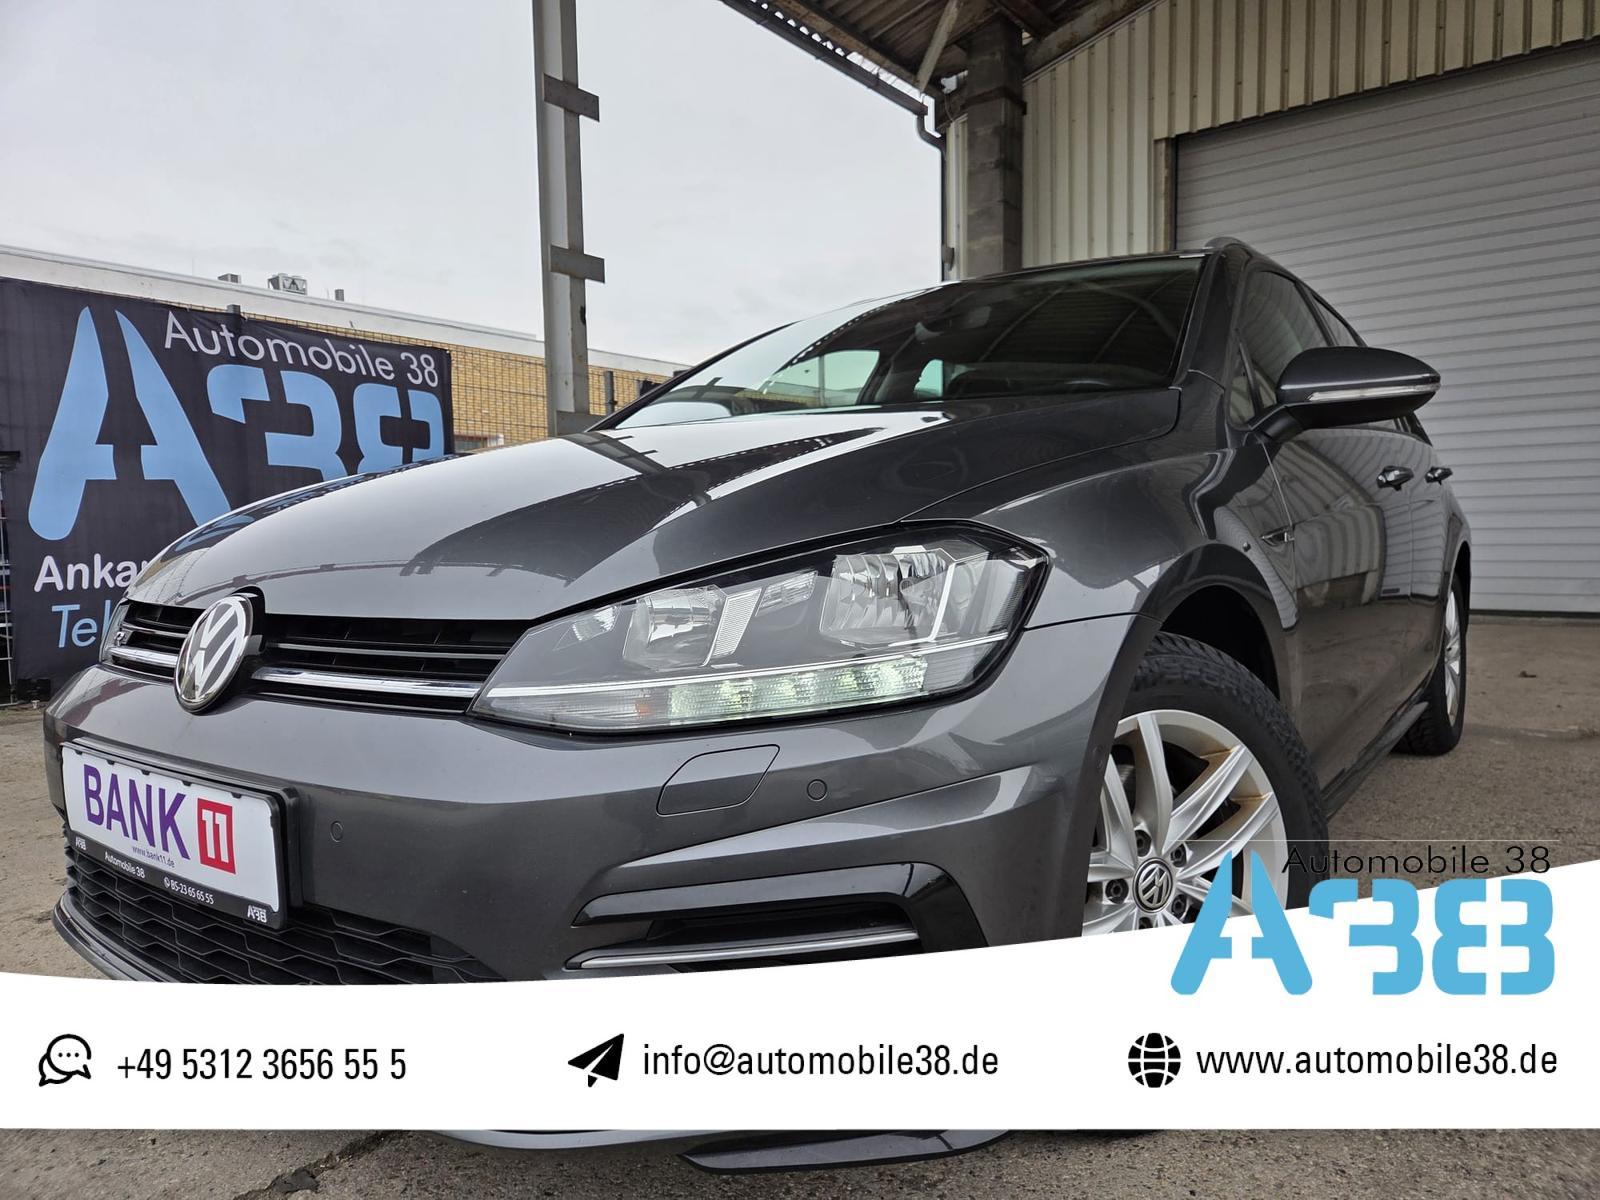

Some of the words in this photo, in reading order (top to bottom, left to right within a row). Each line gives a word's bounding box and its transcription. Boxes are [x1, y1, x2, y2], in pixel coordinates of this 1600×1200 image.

[164, 310, 395, 380] Automobile
[401, 351, 439, 389] 38
[33, 553, 150, 592] Anka
[83, 763, 191, 861] BANK
[200, 808, 230, 864] 11
[104, 851, 136, 875] Automobile
[135, 866, 146, 879] 38
[205, 893, 214, 905] 55
[131, 845, 176, 868] www.bank11.de
